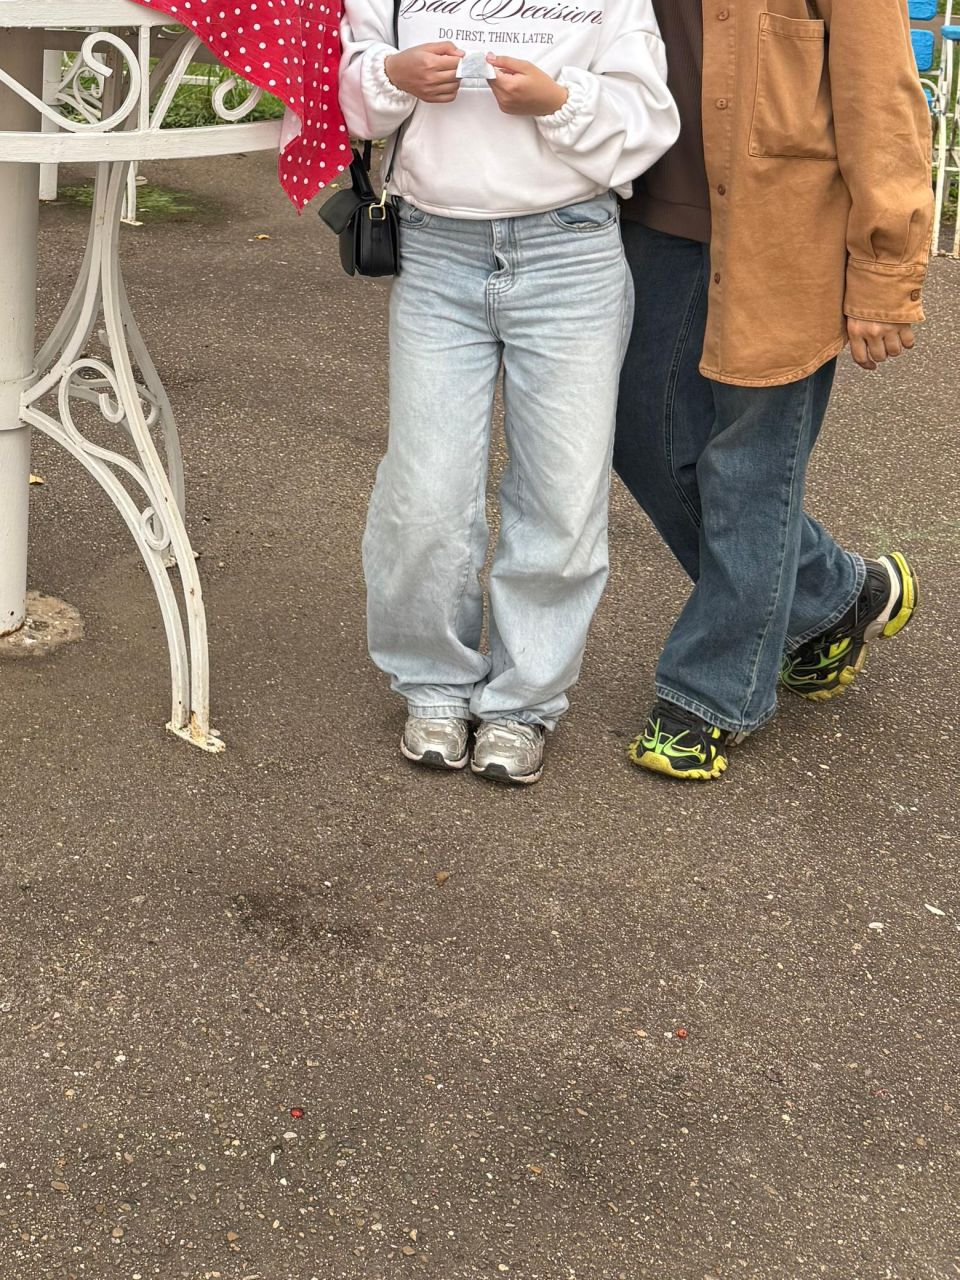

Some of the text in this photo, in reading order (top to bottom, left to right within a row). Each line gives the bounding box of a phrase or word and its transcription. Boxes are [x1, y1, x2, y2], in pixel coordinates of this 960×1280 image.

[438, 27, 555, 45] DO FIRST, THINK LATER
